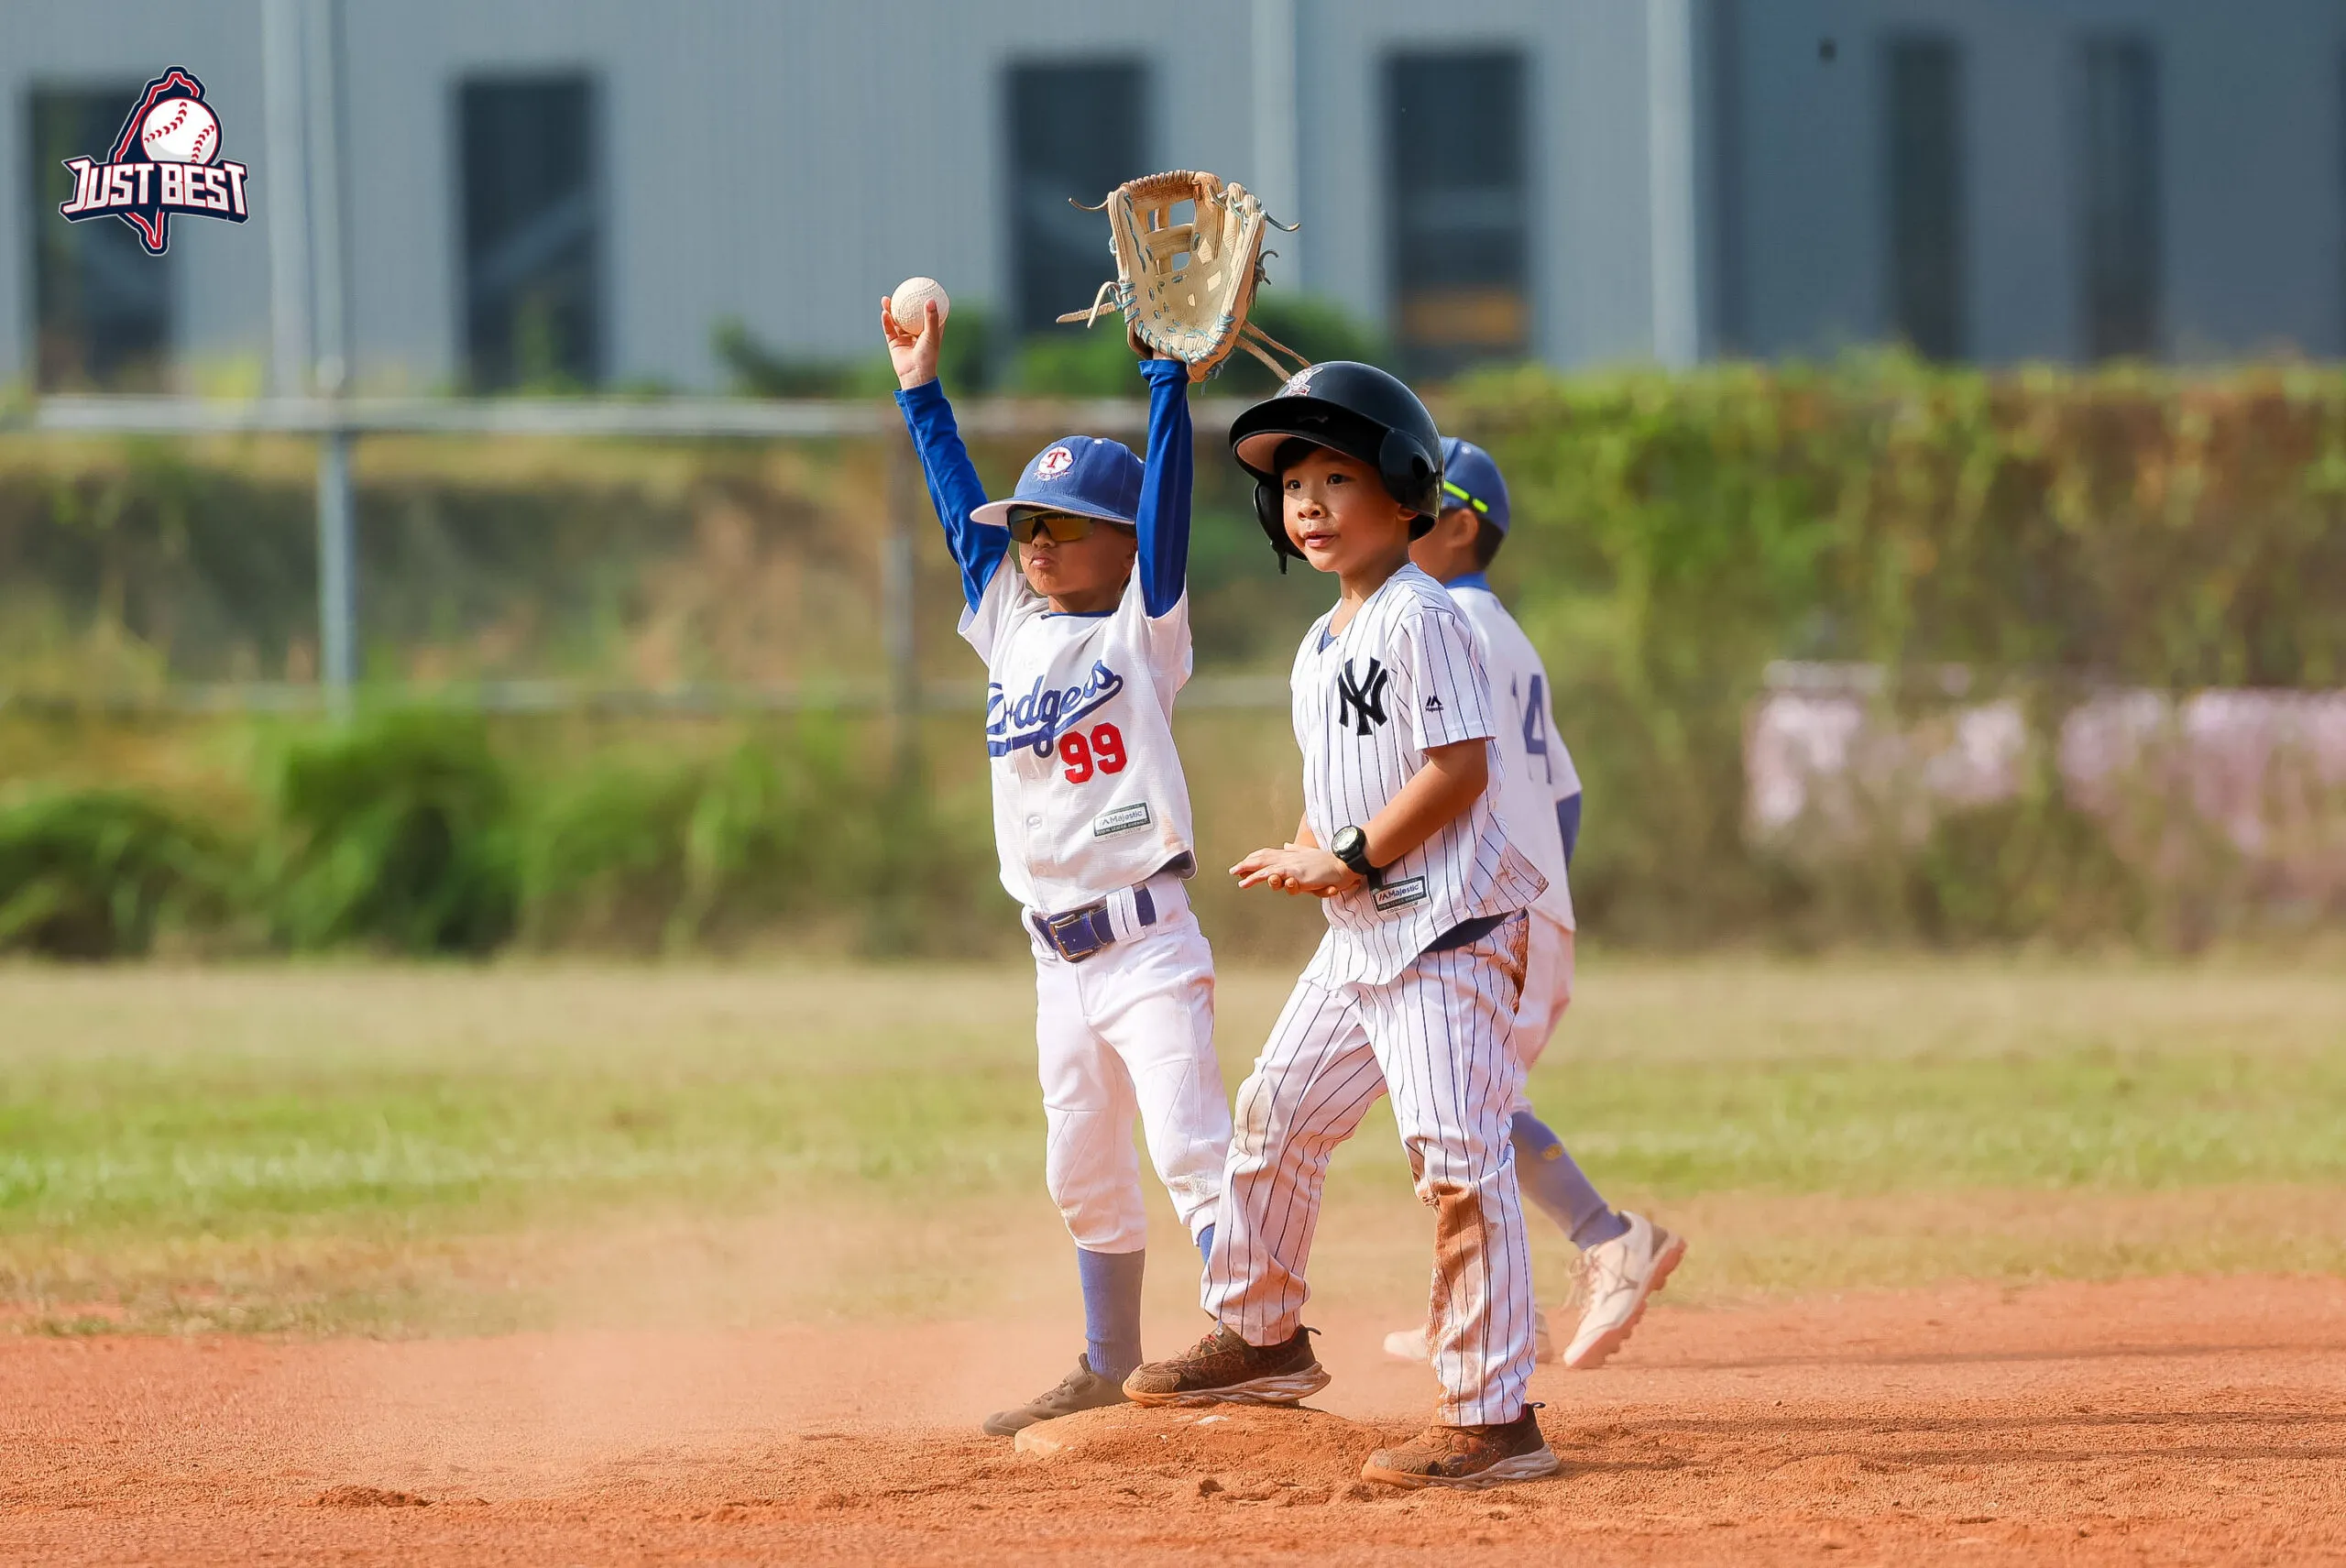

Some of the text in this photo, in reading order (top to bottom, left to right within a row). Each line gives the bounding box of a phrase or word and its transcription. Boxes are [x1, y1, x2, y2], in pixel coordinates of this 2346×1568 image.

[1047, 451, 1067, 468] T
[1337, 656, 1388, 736] NY
[1058, 722, 1128, 784] 99
[1387, 883, 1420, 898] Majestic
